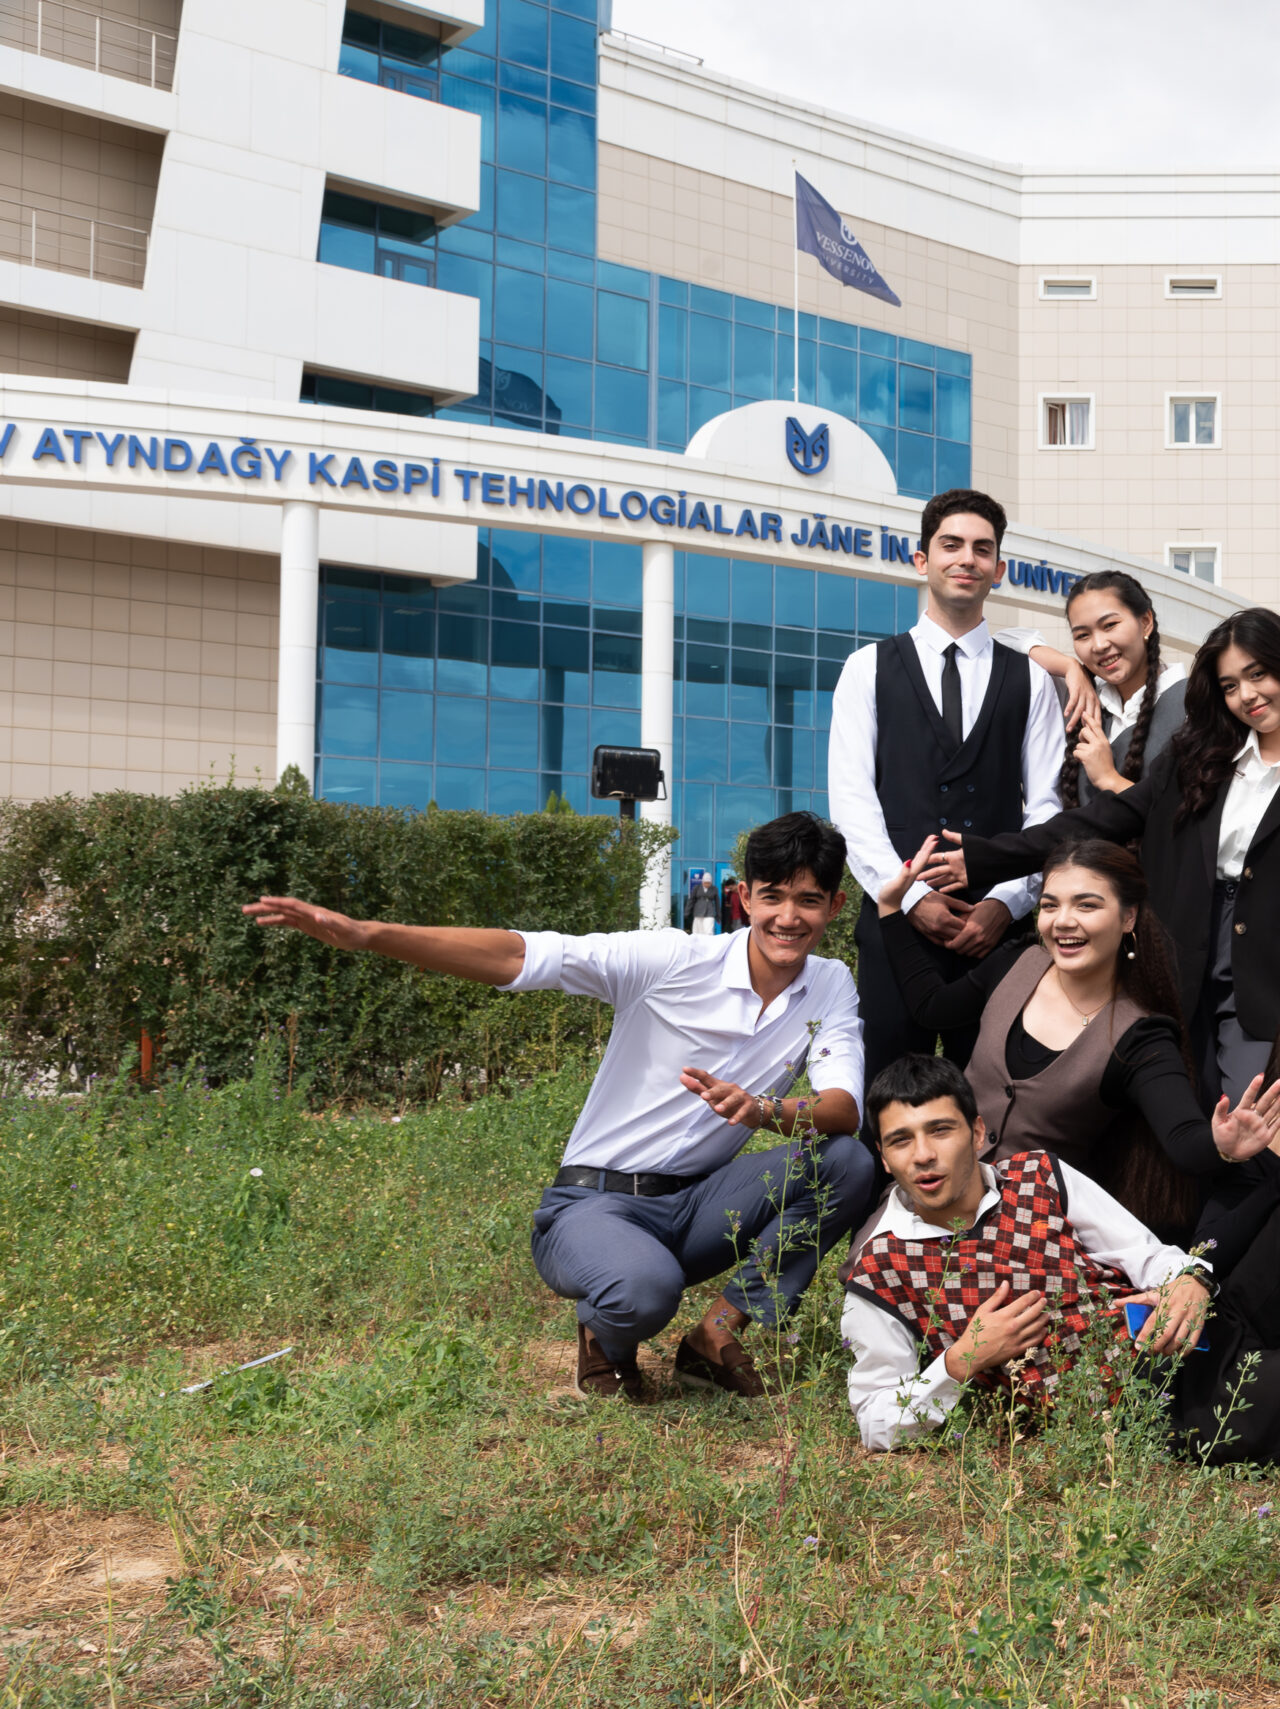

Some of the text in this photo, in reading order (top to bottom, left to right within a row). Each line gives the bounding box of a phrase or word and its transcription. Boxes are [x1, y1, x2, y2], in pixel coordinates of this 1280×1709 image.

[33, 428, 292, 481] ATYNDAĞY
[309, 452, 440, 497] KASPİ
[454, 469, 783, 542] TEHNOLOGİALAR
